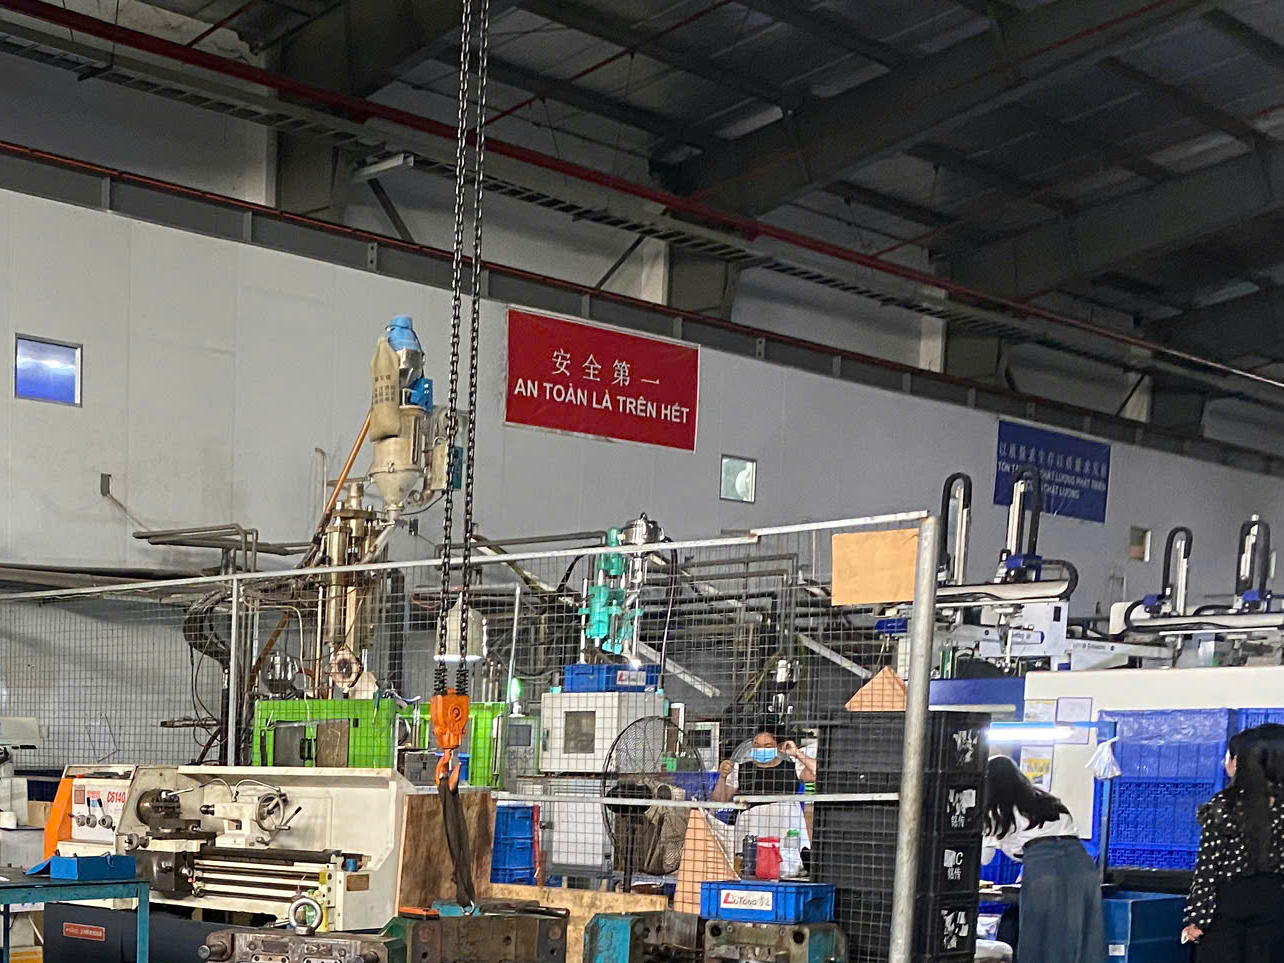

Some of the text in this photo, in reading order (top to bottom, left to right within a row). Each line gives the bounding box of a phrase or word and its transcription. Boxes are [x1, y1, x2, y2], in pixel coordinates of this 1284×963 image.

[551, 347, 660, 387] 安全第一
[514, 378, 538, 398] AN
[543, 382, 588, 406] TOÀN
[592, 389, 612, 411] LÀ
[616, 395, 657, 419] TRÊN
